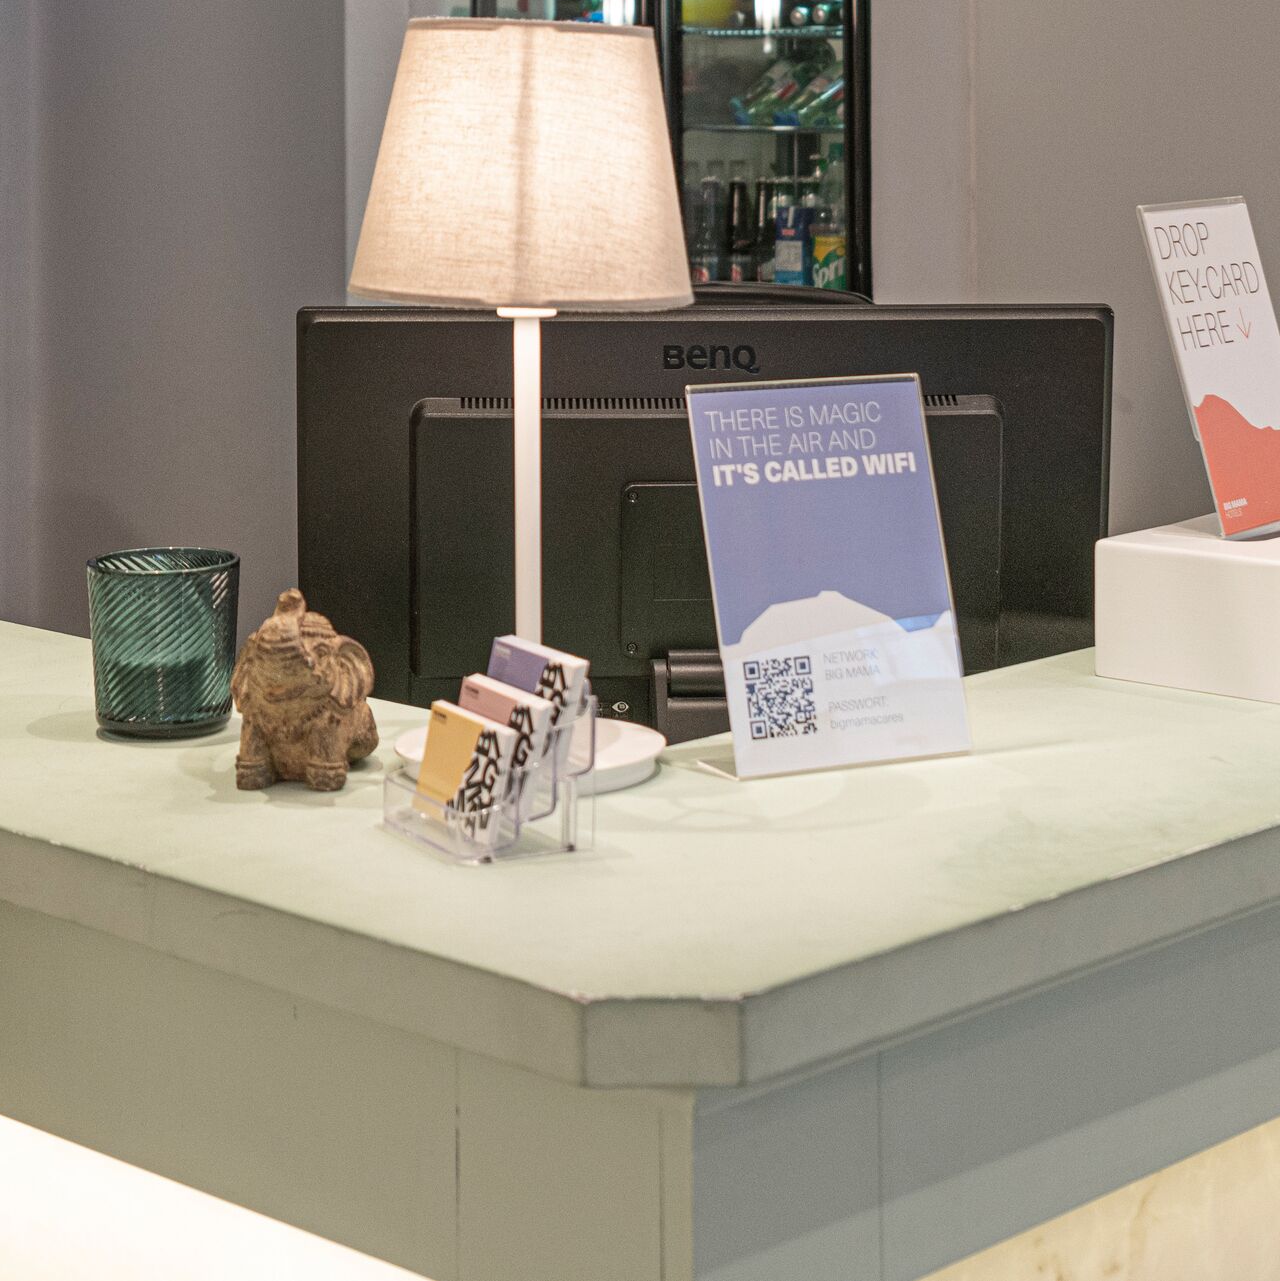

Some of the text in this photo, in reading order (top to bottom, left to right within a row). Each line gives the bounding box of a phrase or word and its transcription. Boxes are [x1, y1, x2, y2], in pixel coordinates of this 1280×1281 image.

[1154, 222, 1209, 260] DROP
[1165, 261, 1260, 305] KEY-CARD
[1177, 310, 1234, 351] HERE
[663, 344, 759, 373] BenQ
[704, 401, 881, 432] THERE IS MAGIC
[709, 428, 876, 459] IN THE AIR AND
[712, 451, 917, 487] IT'S CALLED WIFI
[824, 668, 843, 680] BIG
